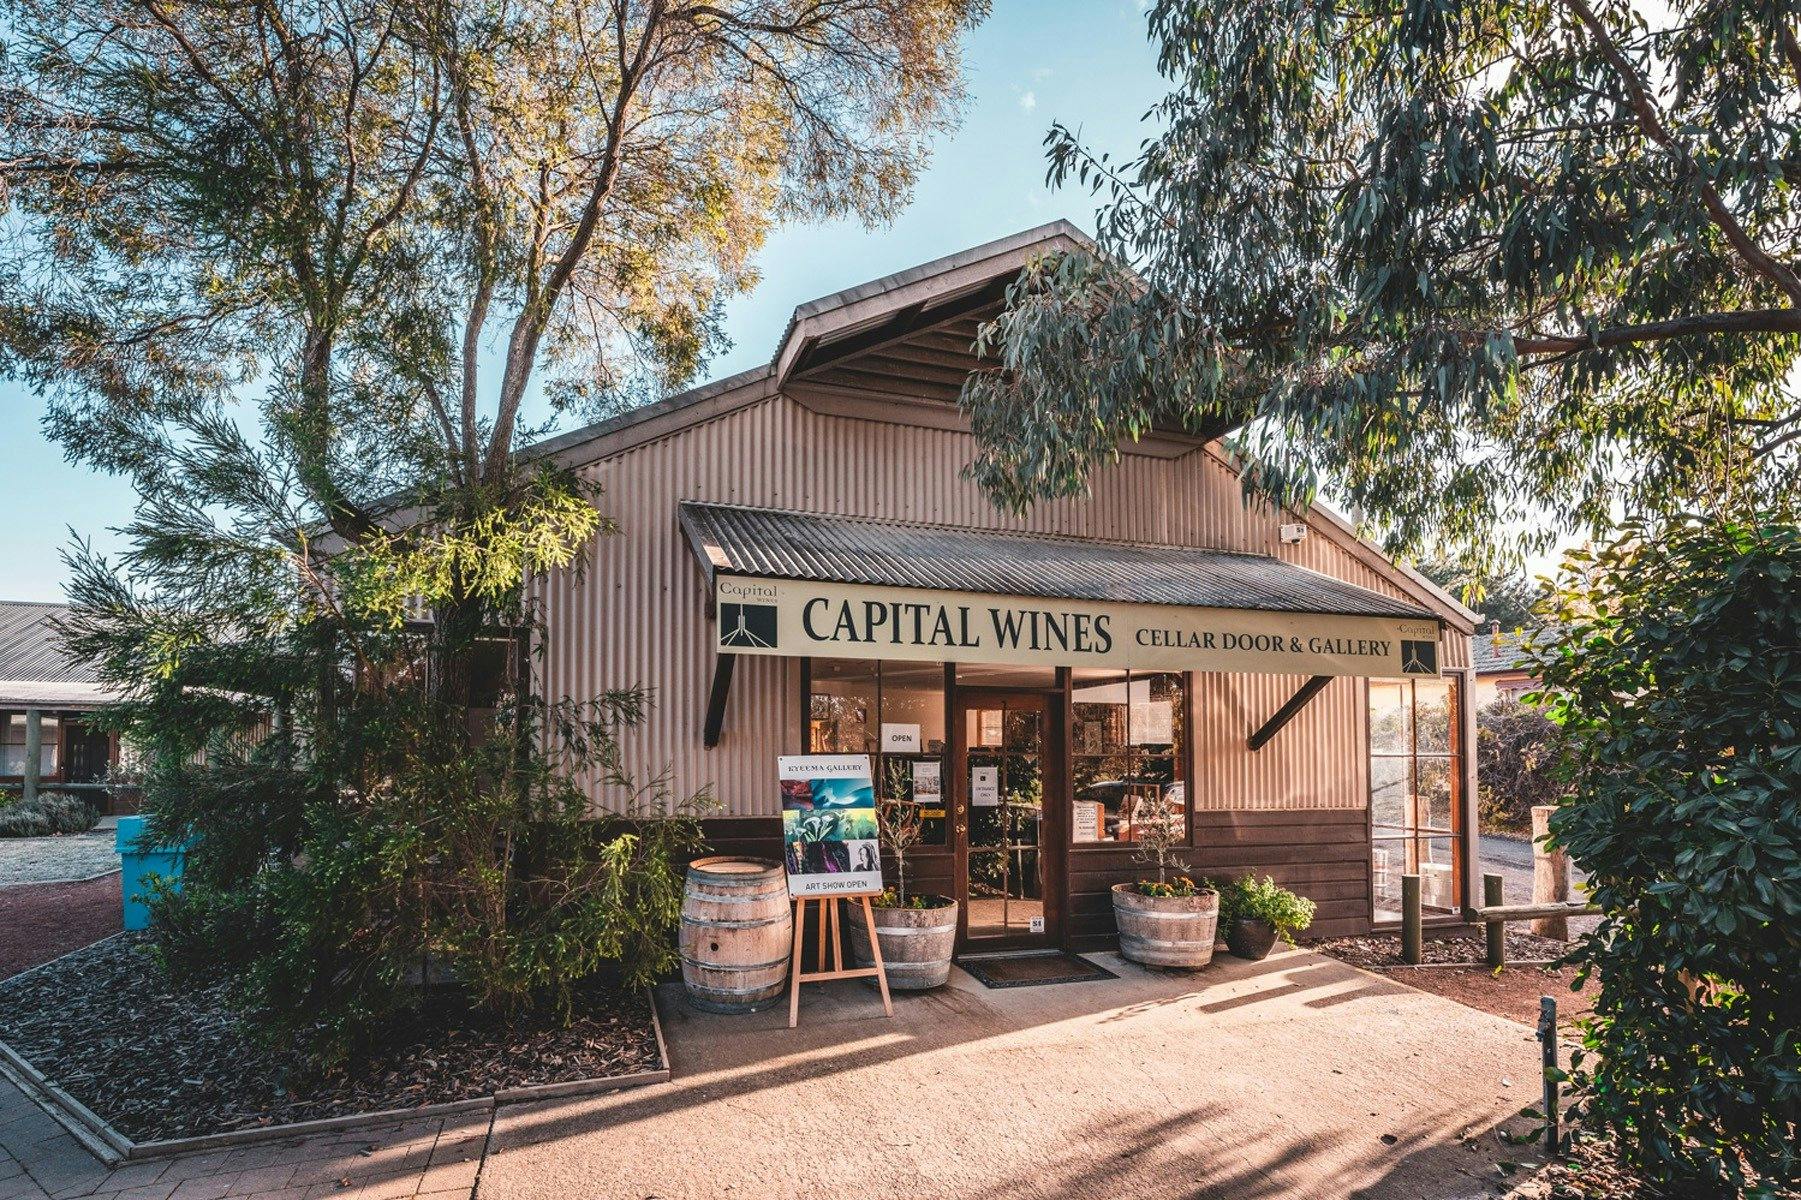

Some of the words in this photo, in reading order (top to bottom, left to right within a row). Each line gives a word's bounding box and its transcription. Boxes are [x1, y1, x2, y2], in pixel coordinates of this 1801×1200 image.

[720, 581, 777, 599] Capital
[802, 597, 980, 648] CAPITAL
[988, 608, 1113, 654] WINES
[1136, 628, 1218, 650] CELLAR
[1222, 632, 1284, 652] DOOR
[1290, 636, 1303, 654] &
[1309, 637, 1391, 657] GALLERY
[892, 734, 912, 742] OPEN
[826, 764, 863, 773] GALLERY
[805, 882, 821, 891] ART
[822, 881, 846, 890] SHOW
[846, 880, 867, 889] OPEN
